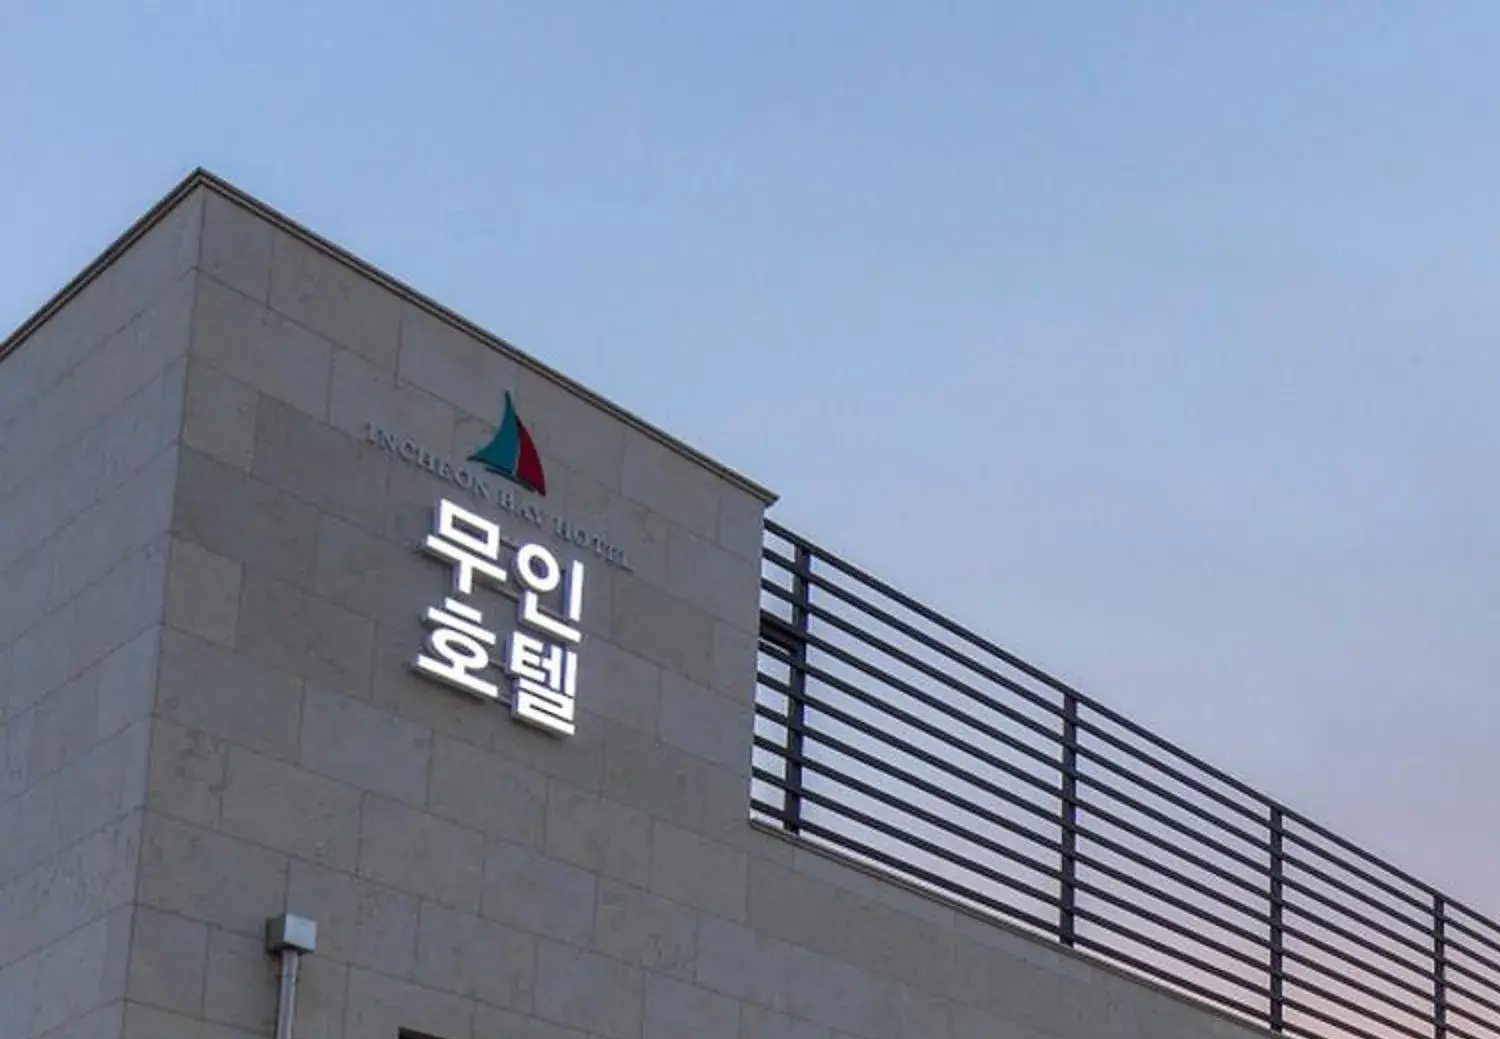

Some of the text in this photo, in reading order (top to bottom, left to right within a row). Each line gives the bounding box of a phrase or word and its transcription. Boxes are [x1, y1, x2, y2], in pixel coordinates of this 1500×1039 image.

[363, 421, 494, 502] INCHEON
[424, 498, 584, 643] 무인
[414, 596, 579, 737] 호텔
